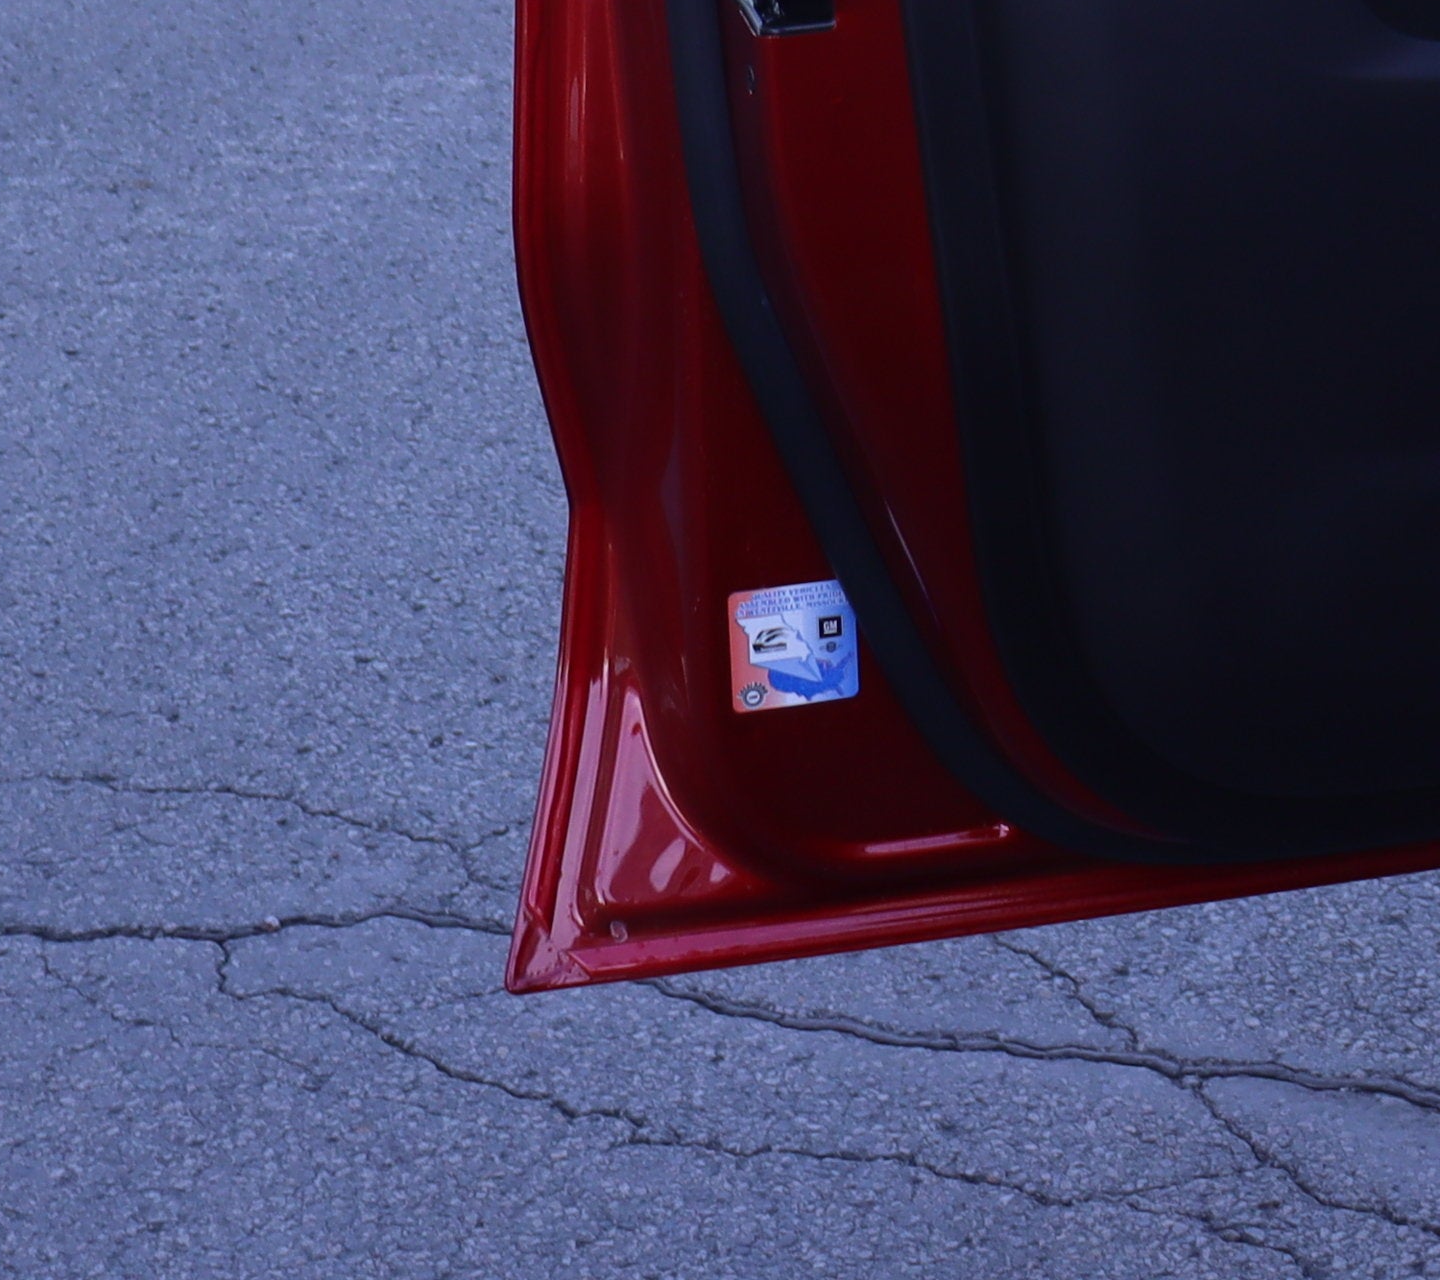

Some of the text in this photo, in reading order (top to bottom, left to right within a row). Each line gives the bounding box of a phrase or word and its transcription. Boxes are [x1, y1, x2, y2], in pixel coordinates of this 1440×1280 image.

[739, 596, 791, 610] ASSEMBLED
[792, 593, 816, 604] WITH
[752, 589, 786, 600] QUALITY
[823, 620, 838, 635] GM
